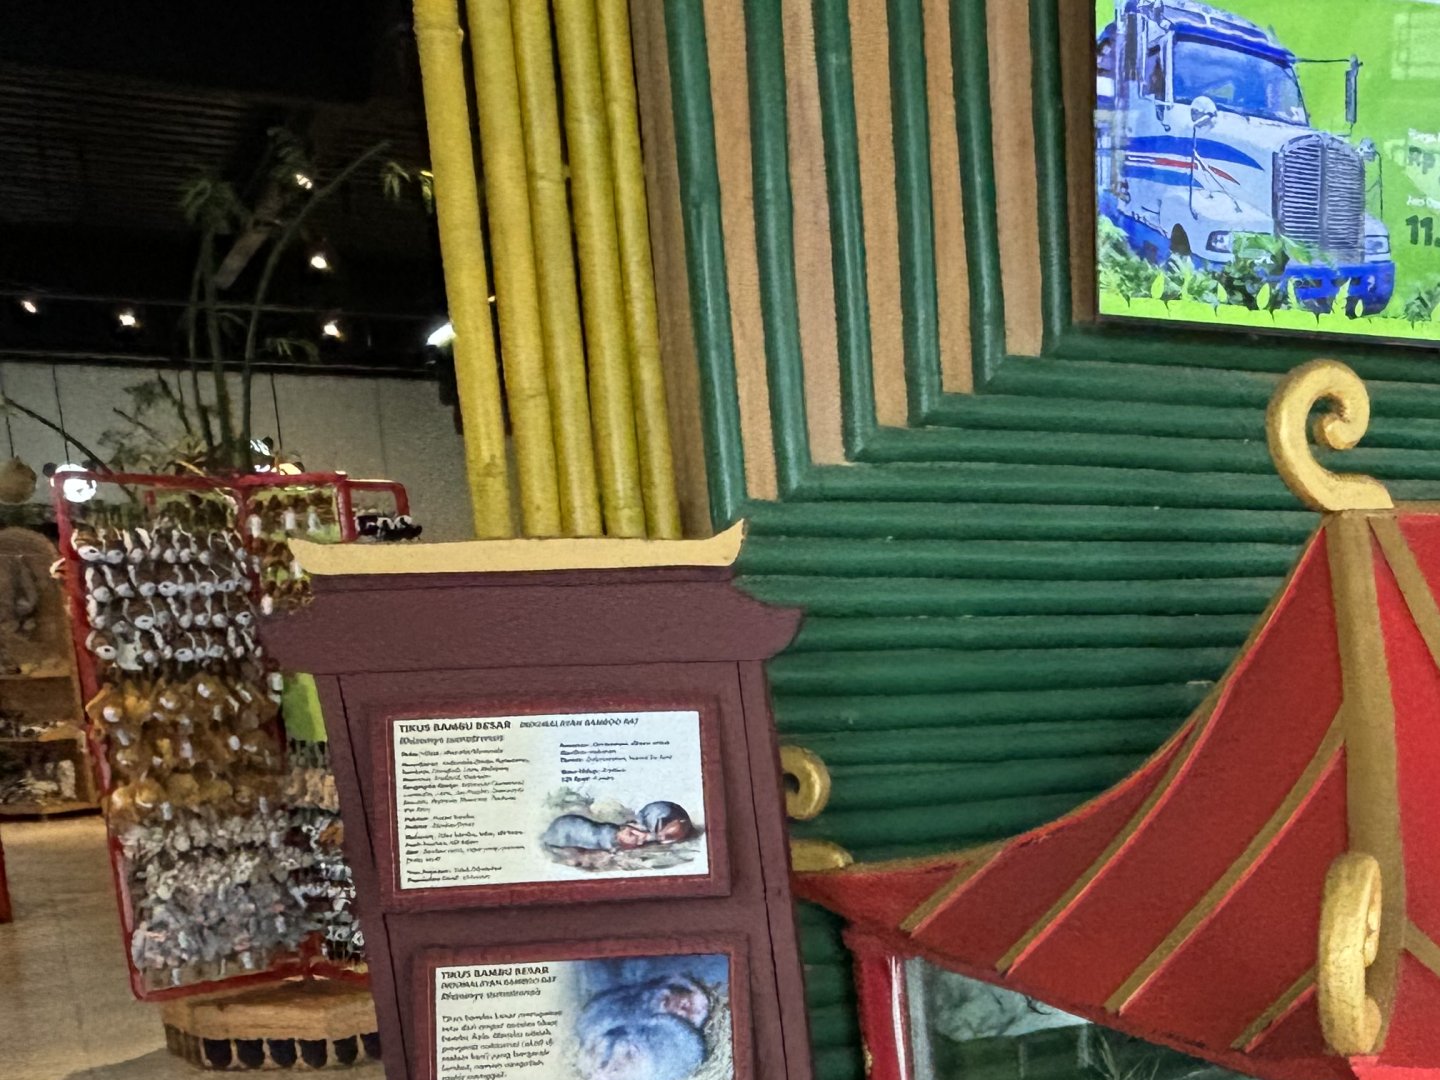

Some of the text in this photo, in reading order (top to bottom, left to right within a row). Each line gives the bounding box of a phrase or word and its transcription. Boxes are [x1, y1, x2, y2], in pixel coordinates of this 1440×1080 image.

[399, 724, 430, 733] TIKUS
[433, 722, 473, 731] BAMBU
[476, 720, 511, 730] BESAR
[441, 970, 471, 979] TIKUS
[474, 968, 512, 978] BAMBU
